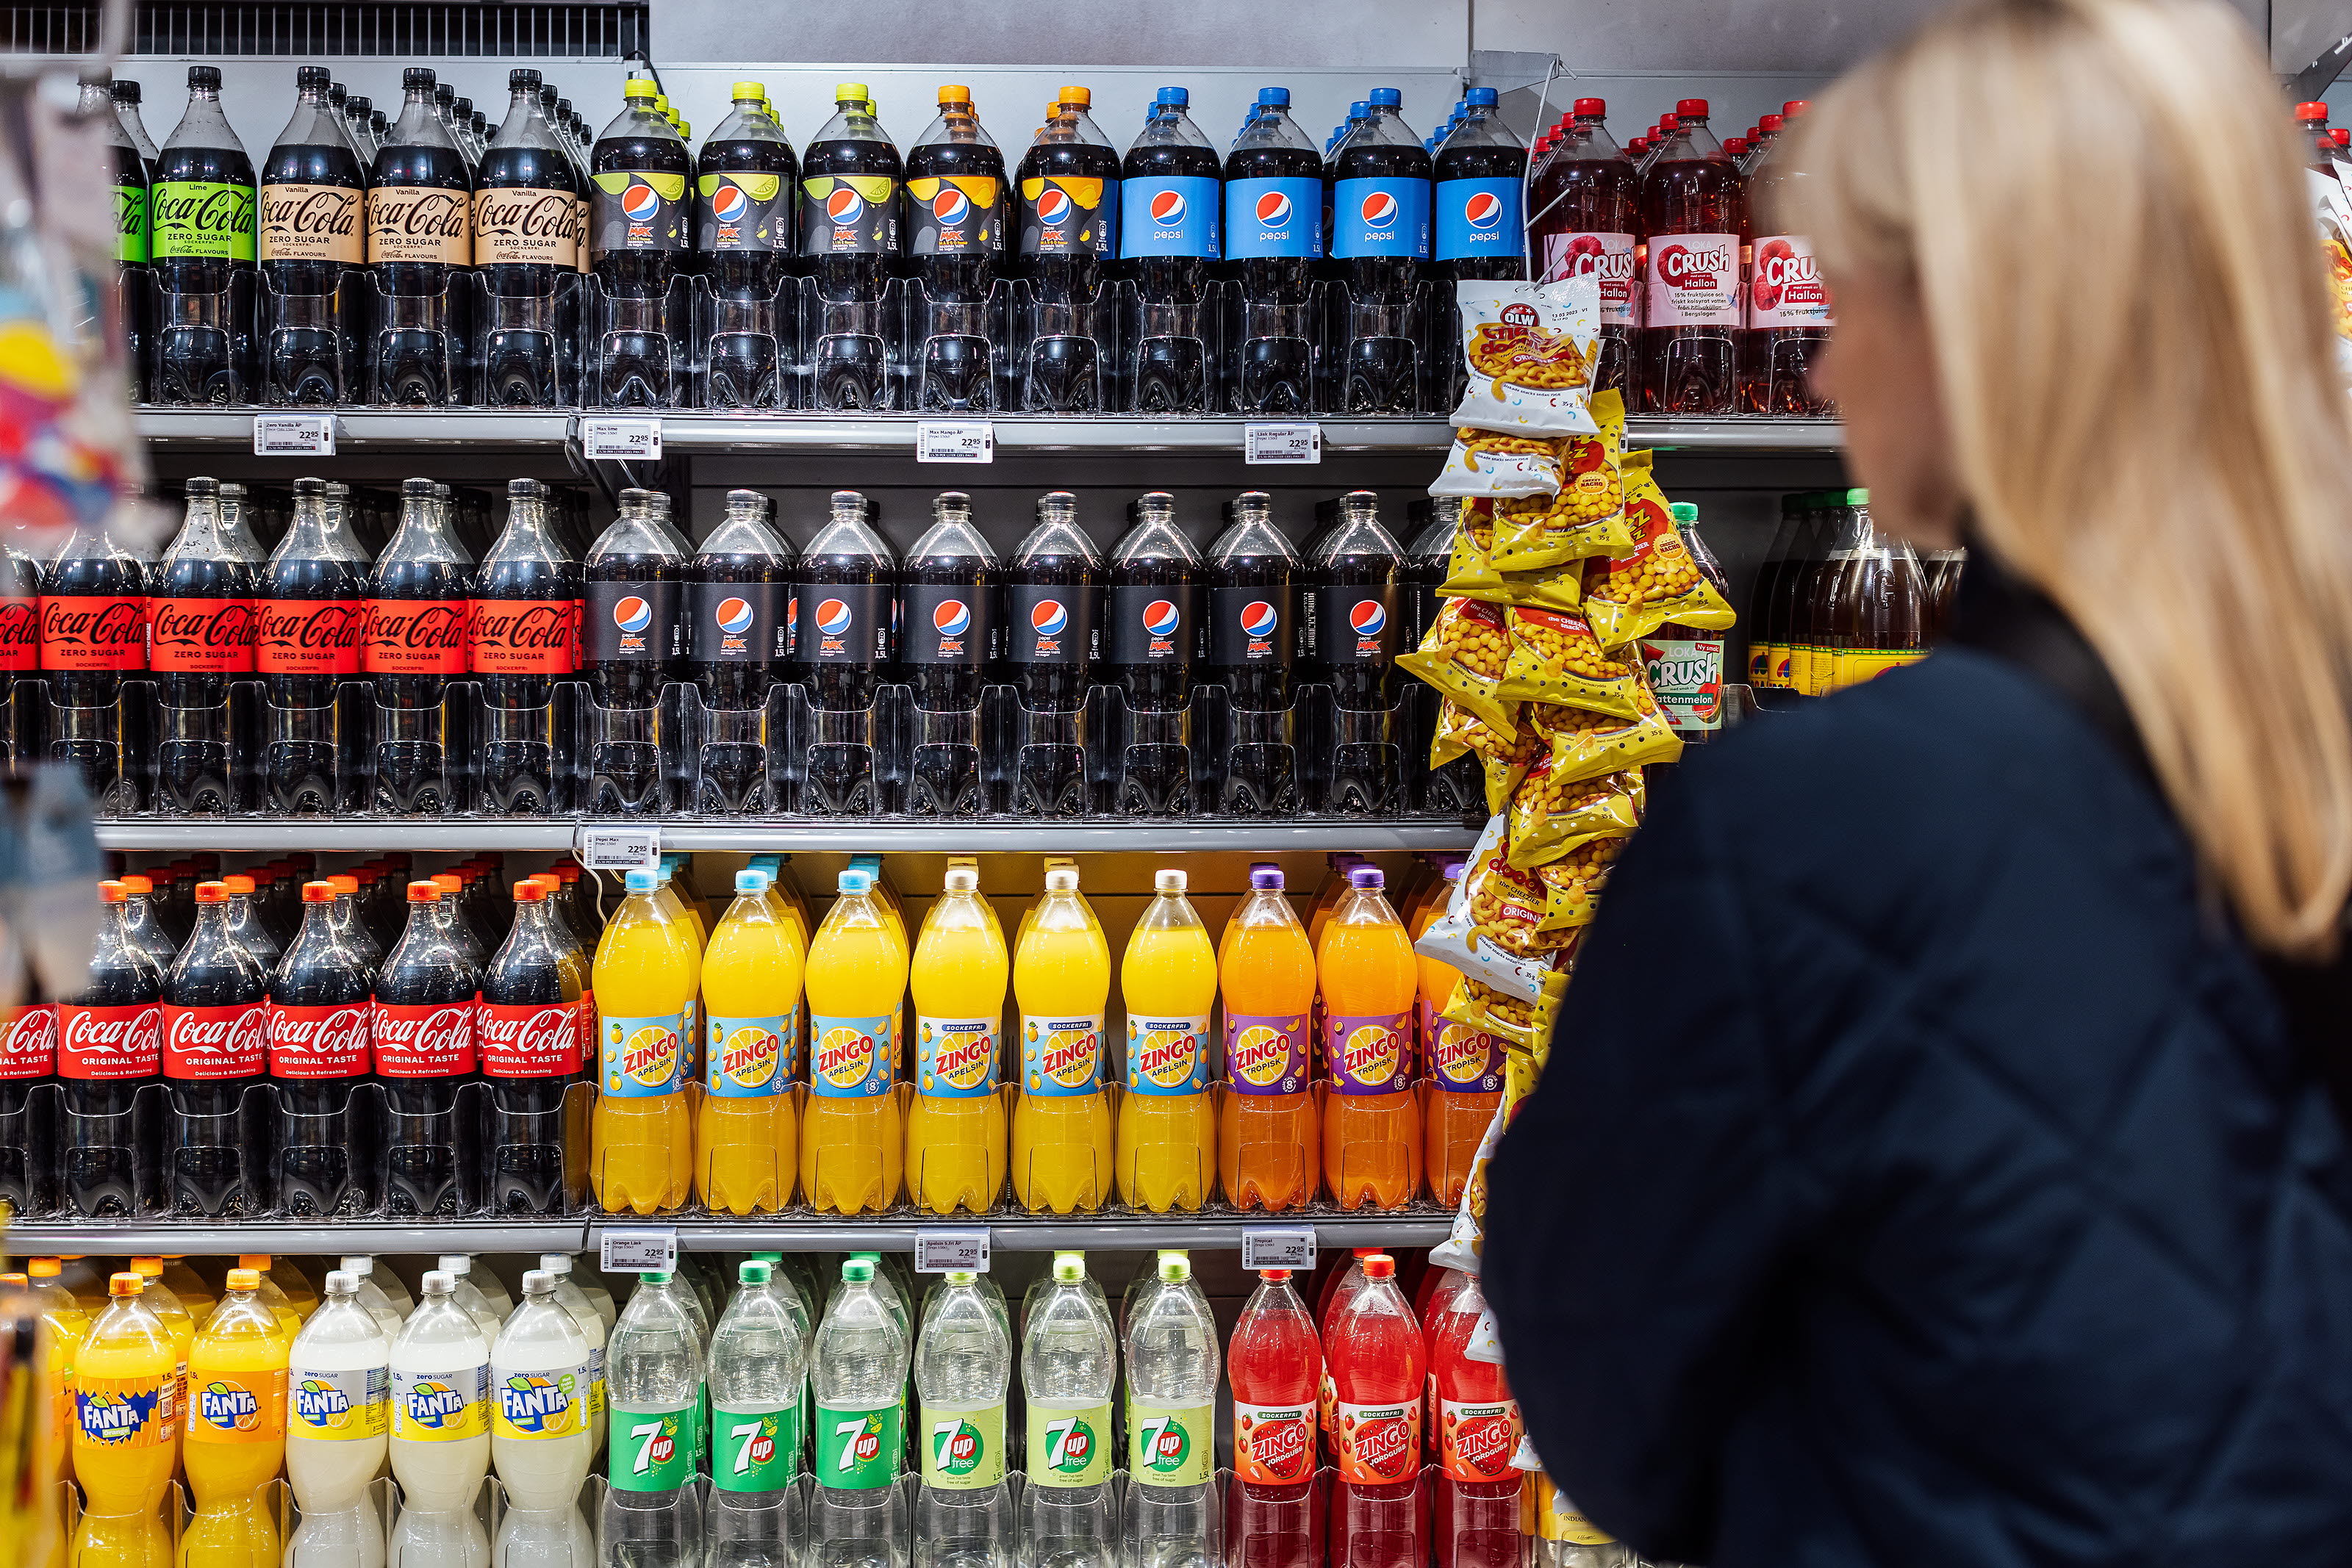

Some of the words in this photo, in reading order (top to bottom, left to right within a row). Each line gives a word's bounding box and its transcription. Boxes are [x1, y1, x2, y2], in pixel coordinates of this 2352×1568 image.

[395, 188, 420, 196] Vanilla
[152, 188, 257, 234] Coca-Cola
[260, 191, 359, 236] Coca-Cola
[368, 193, 469, 238] Coca-Cola
[476, 193, 575, 240] Coca-Cola
[196, 234, 232, 242] SUGAR
[269, 235, 295, 243] ZERO
[297, 236, 330, 245] SUGAR
[379, 237, 404, 246] ZERO
[406, 237, 441, 246] SUGAR
[493, 239, 518, 247] ZERO
[521, 239, 557, 248] SUGAR
[1153, 229, 1183, 241] pepsi
[1259, 230, 1289, 242] pepsi
[1365, 231, 1394, 242] pepsi
[1469, 231, 1499, 243] pepsi
[1688, 241, 1712, 250] LOKA
[1667, 243, 1730, 278] CRUSh
[1685, 278, 1715, 288] Hallon
[1788, 289, 1823, 301] Hallon
[1504, 312, 1536, 327] OLW
[1660, 543, 1681, 554] NACHO
[43, 602, 145, 647] Coca-Cola
[151, 605, 254, 647] Coca-Cola
[259, 605, 359, 648] Coca-Cola
[368, 605, 465, 649] Coca-Cola
[473, 605, 568, 648] Coca-Cola
[1560, 622, 1581, 631] snack
[60, 649, 87, 657] ZERO
[90, 649, 126, 657] SUGAR
[204, 651, 238, 659] SUGAR
[1668, 646, 1697, 658] LOKA
[1646, 652, 1717, 691] CRUSh
[1499, 880, 1510, 889] the
[1510, 885, 1541, 907] CHEEZIER
[1502, 906, 1542, 924] ORIGINA
[270, 1007, 368, 1054] Coca-Cola
[376, 1007, 471, 1054] Coca-Cola
[482, 1006, 578, 1052] Coca-Cola
[82, 1056, 132, 1065] ORIGINAL
[135, 1053, 159, 1063] TASTE
[185, 1056, 236, 1065] ORIGINAL
[239, 1053, 262, 1063] TASTE
[279, 1055, 323, 1065] ORIGINAL
[326, 1054, 357, 1063] TASTE
[382, 1054, 426, 1064] ORIGINAL
[430, 1053, 459, 1062] TASTE
[487, 1054, 528, 1064] ORIGINAL
[530, 1054, 562, 1063] TASTE
[623, 1032, 678, 1075] ZINGO
[723, 1033, 779, 1076] ZINGO
[818, 1035, 874, 1073] ZINGO
[936, 1035, 992, 1076] ZINGO
[1042, 1033, 1097, 1076] ZINGO
[1140, 1035, 1197, 1075] ZINGO
[1235, 1033, 1291, 1073] ZINGO
[1344, 1031, 1400, 1074] ZINGO
[1438, 1032, 1492, 1070] ZINGO
[637, 1057, 672, 1078] APELSIN
[736, 1058, 771, 1078] APELSIN
[828, 1059, 864, 1078] APELSIN
[947, 1060, 984, 1079] APELSIN
[1055, 1057, 1091, 1079] APELSIN
[1151, 1058, 1188, 1078] APELSIN
[1245, 1057, 1282, 1076] TROPISK
[1356, 1055, 1394, 1076] TROPISK
[1446, 1055, 1482, 1073] TROPISK
[201, 1389, 257, 1416] FANTA
[296, 1388, 349, 1413] FANTA
[406, 1391, 465, 1416] FANTA
[500, 1386, 569, 1417] FANTA
[83, 1400, 138, 1428] FANTA
[513, 1417, 533, 1425] Lemon
[104, 1428, 129, 1437] Orange
[1064, 1455, 1087, 1467] free
[1157, 1455, 1180, 1466] free
[1265, 1445, 1303, 1467] JORDGUBB
[1369, 1443, 1406, 1467] JORDGUBB
[1471, 1442, 1508, 1464] JORDGUBB
[951, 1458, 975, 1469] free
[1563, 1514, 1587, 1522] INDIAN
